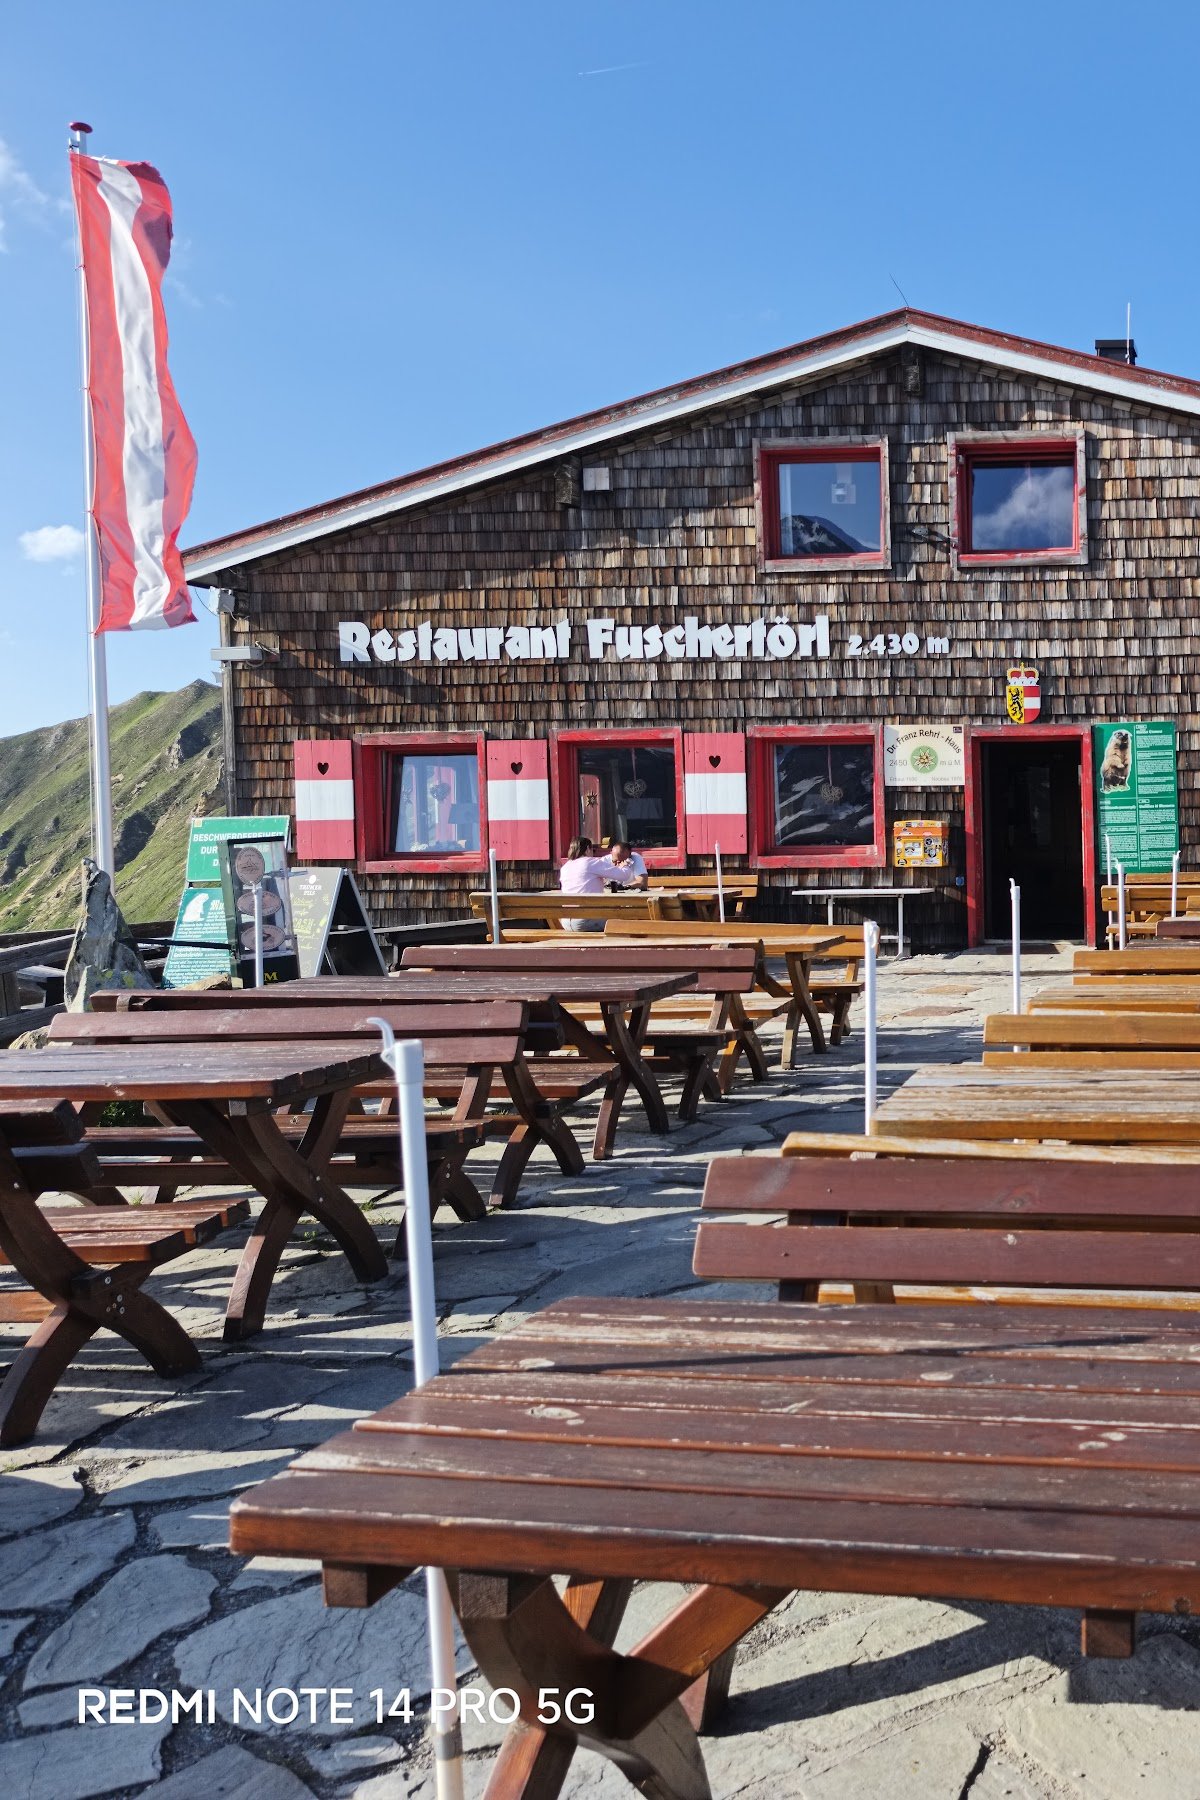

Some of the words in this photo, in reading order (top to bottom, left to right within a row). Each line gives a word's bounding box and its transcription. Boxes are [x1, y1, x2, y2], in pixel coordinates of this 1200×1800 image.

[338, 618, 571, 662] Restaurant
[587, 615, 830, 660] Fuschertörl
[849, 632, 920, 655] 2.430
[927, 635, 949, 654] m
[886, 744, 898, 754] Dr.
[896, 731, 917, 744] Franz
[919, 729, 940, 739] Rehrl
[945, 736, 962, 754] Haus
[889, 759, 908, 767] 2450
